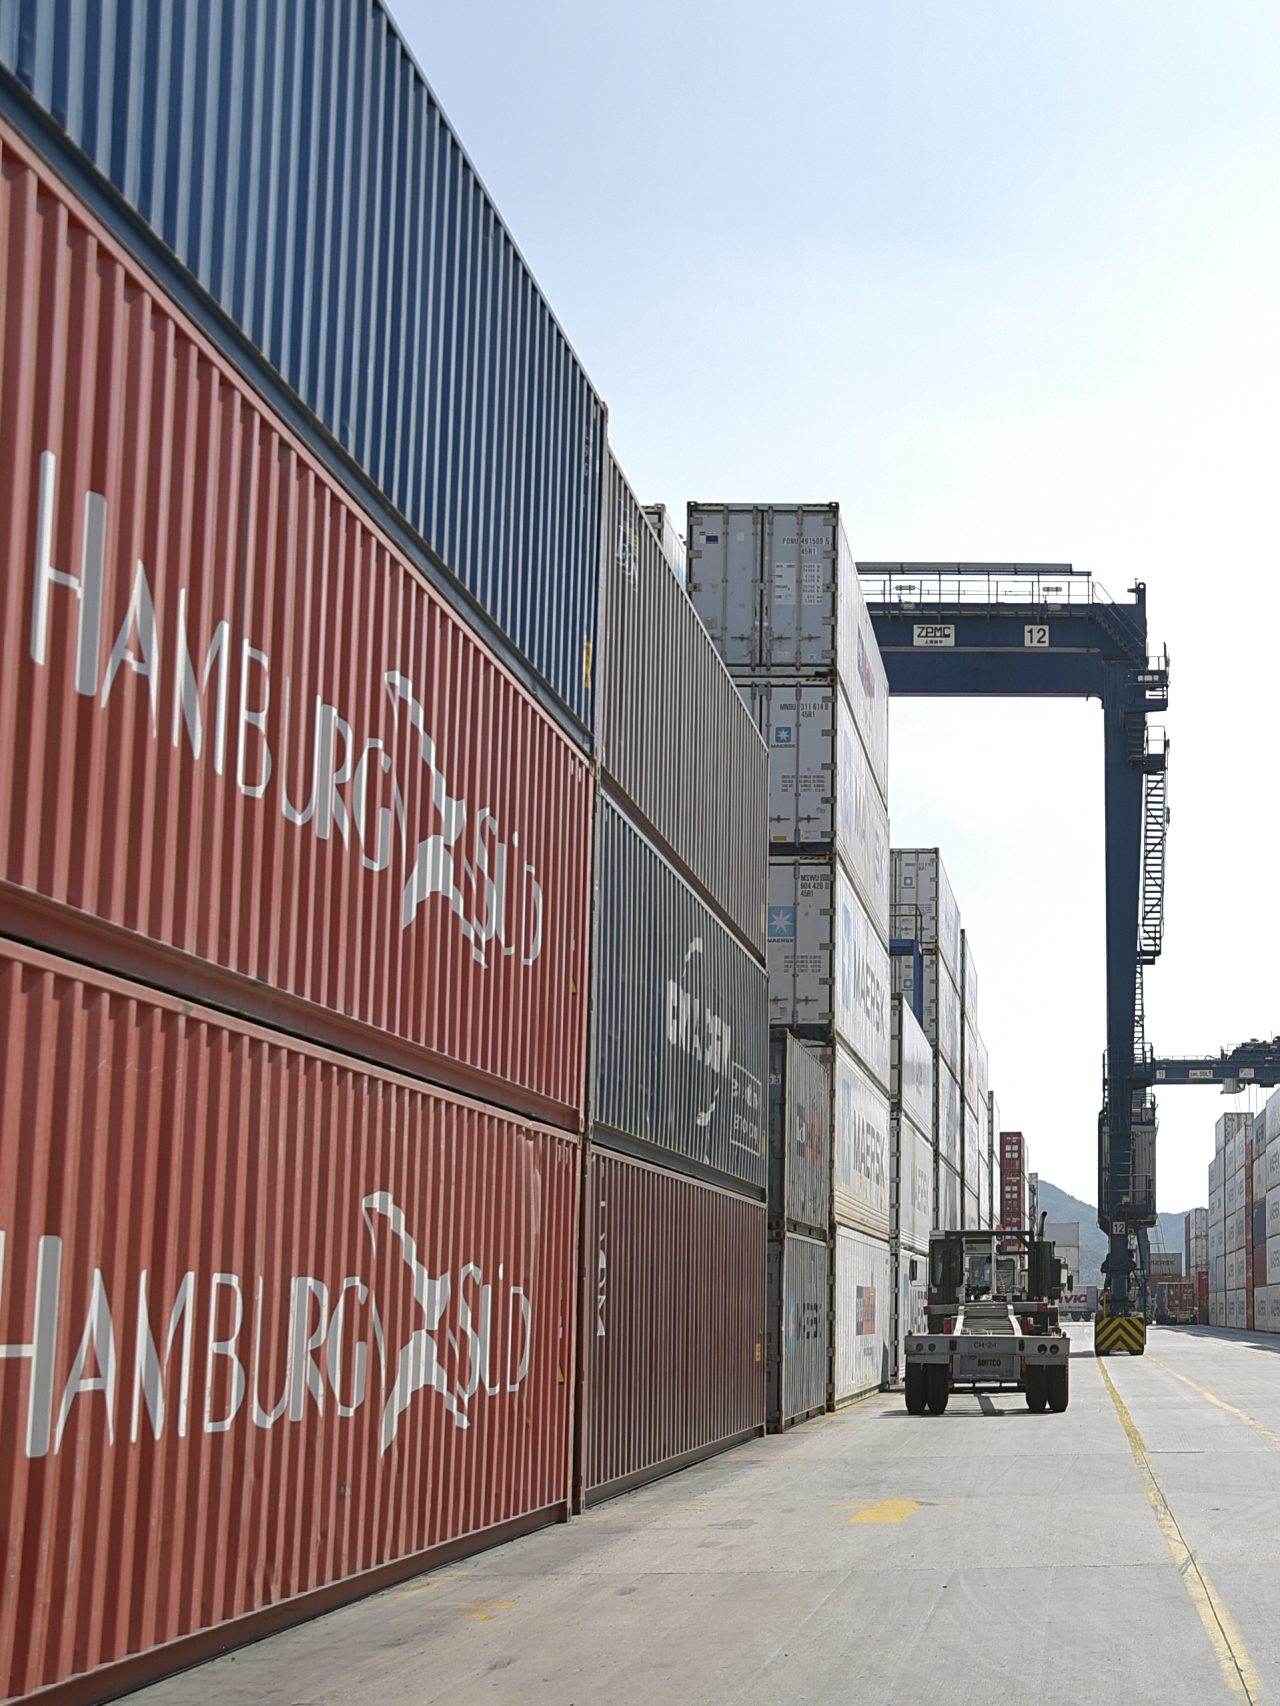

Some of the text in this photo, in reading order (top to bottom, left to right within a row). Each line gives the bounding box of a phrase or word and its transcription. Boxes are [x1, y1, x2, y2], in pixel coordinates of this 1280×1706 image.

[917, 626, 951, 638] ZPMC
[1026, 627, 1047, 644] 12
[30, 450, 392, 874] HAMBURG
[1113, 1224, 1125, 1233] 12
[0, 1230, 369, 1458] HAMBURG
[973, 1341, 997, 1349] CH-24
